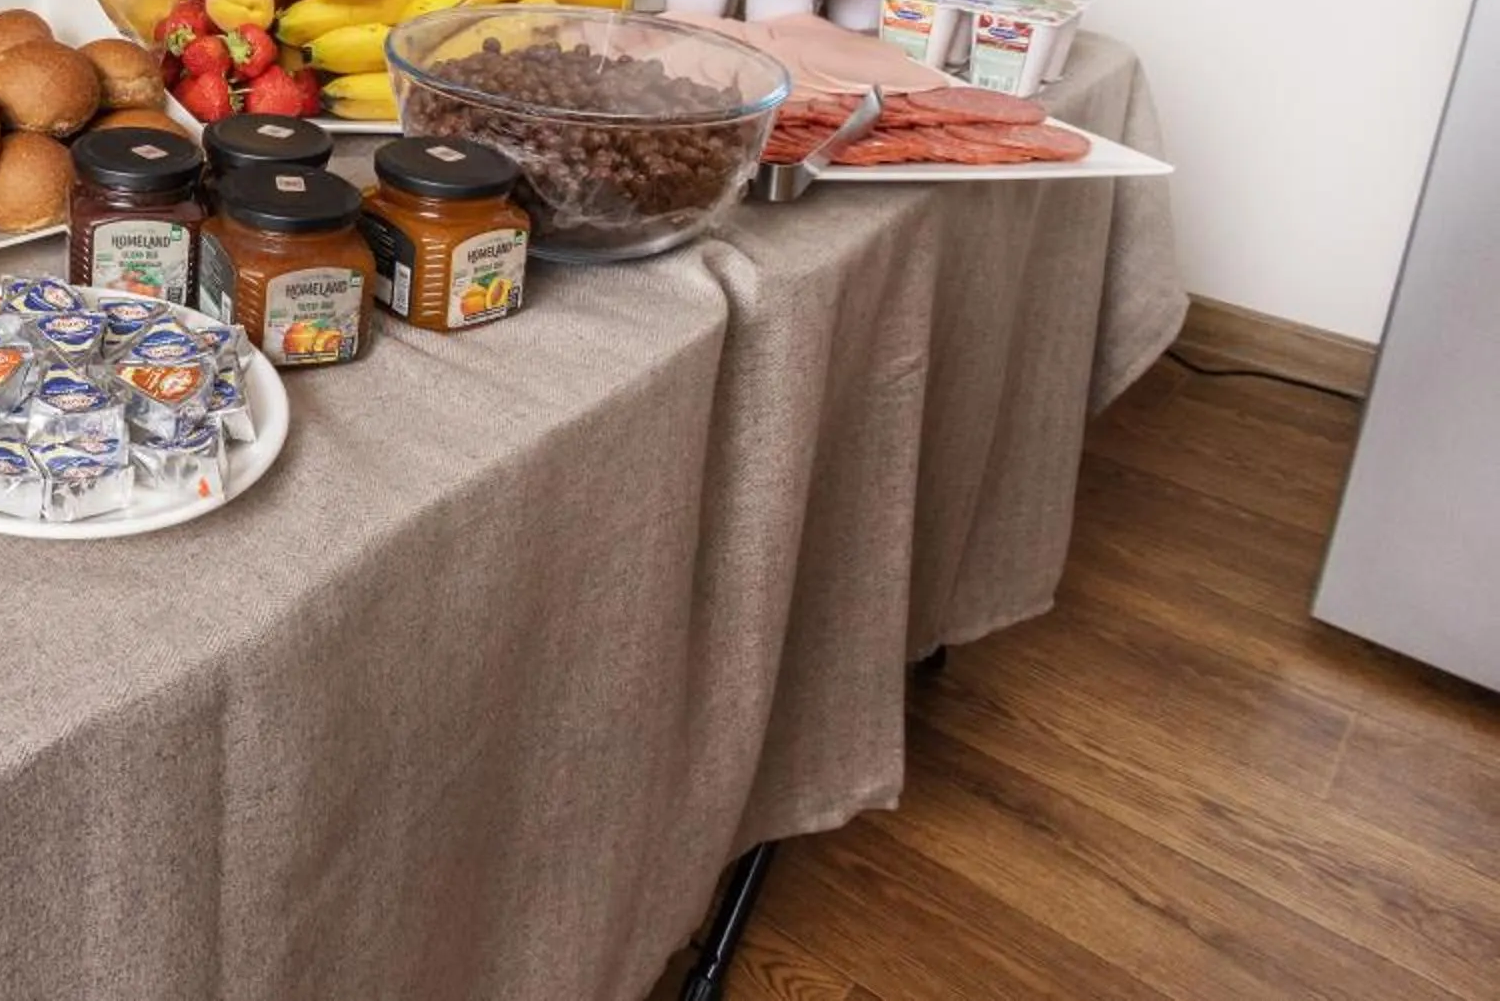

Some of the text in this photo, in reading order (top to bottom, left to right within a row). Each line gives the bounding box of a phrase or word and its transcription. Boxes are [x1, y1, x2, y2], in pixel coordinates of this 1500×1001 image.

[111, 234, 171, 250] HOMELAND
[467, 241, 514, 264] HOMELAND
[285, 280, 348, 300] HOMELAND
